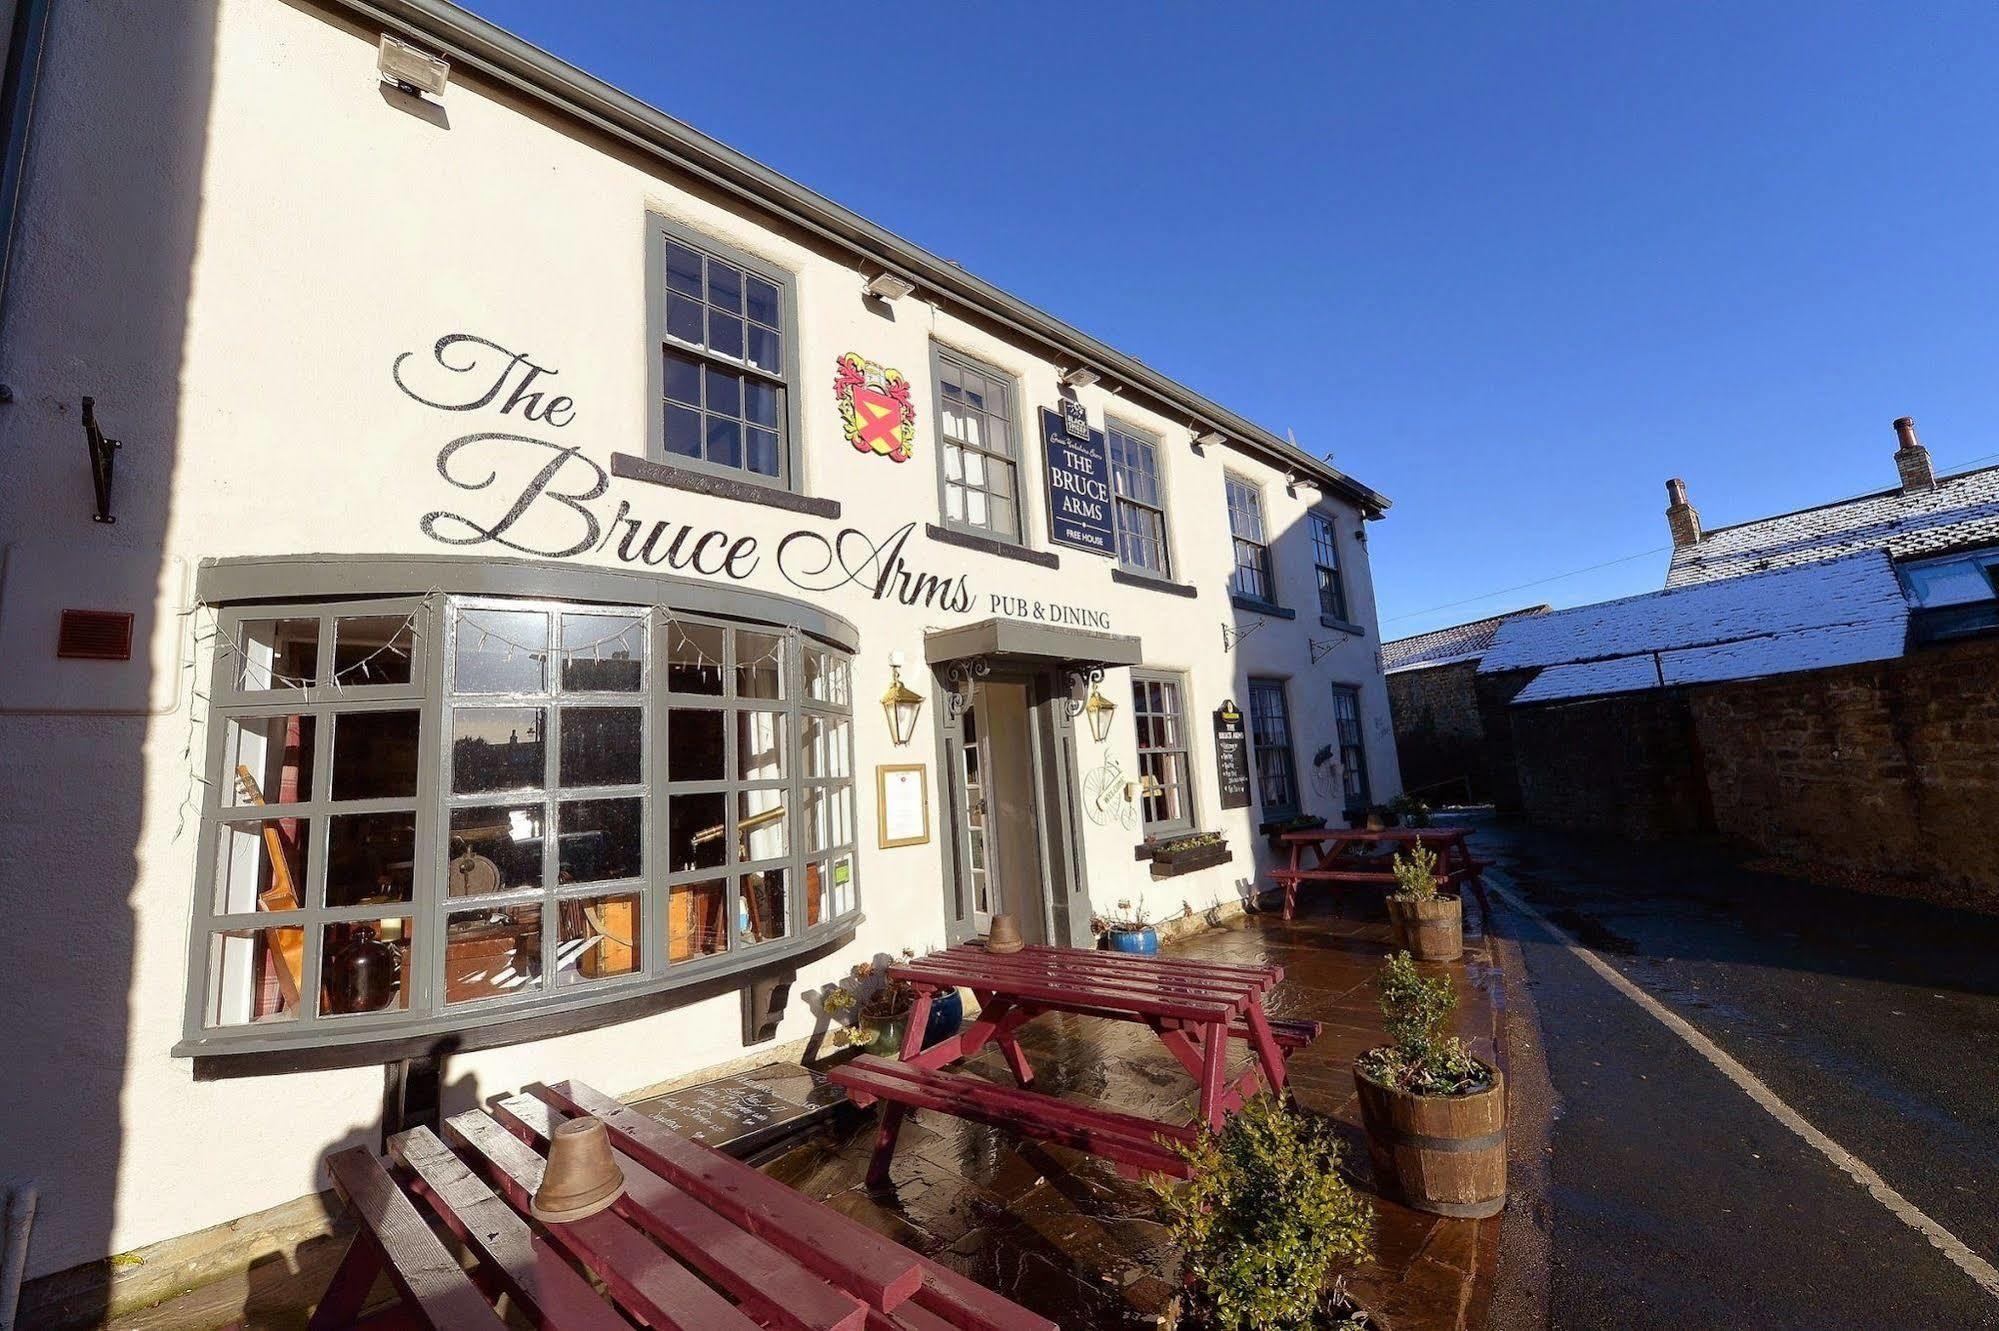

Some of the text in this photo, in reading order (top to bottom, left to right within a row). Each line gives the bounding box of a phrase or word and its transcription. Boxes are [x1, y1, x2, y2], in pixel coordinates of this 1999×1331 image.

[393, 334, 576, 427] The
[1063, 450, 1094, 475] THE
[1051, 466, 1109, 503] BRUCE
[420, 432, 977, 613] Bruce Arms
[1062, 495, 1102, 521] ARMS
[1066, 528, 1104, 546] FREE HOUSE
[990, 594, 1110, 629] PUB & DINING
